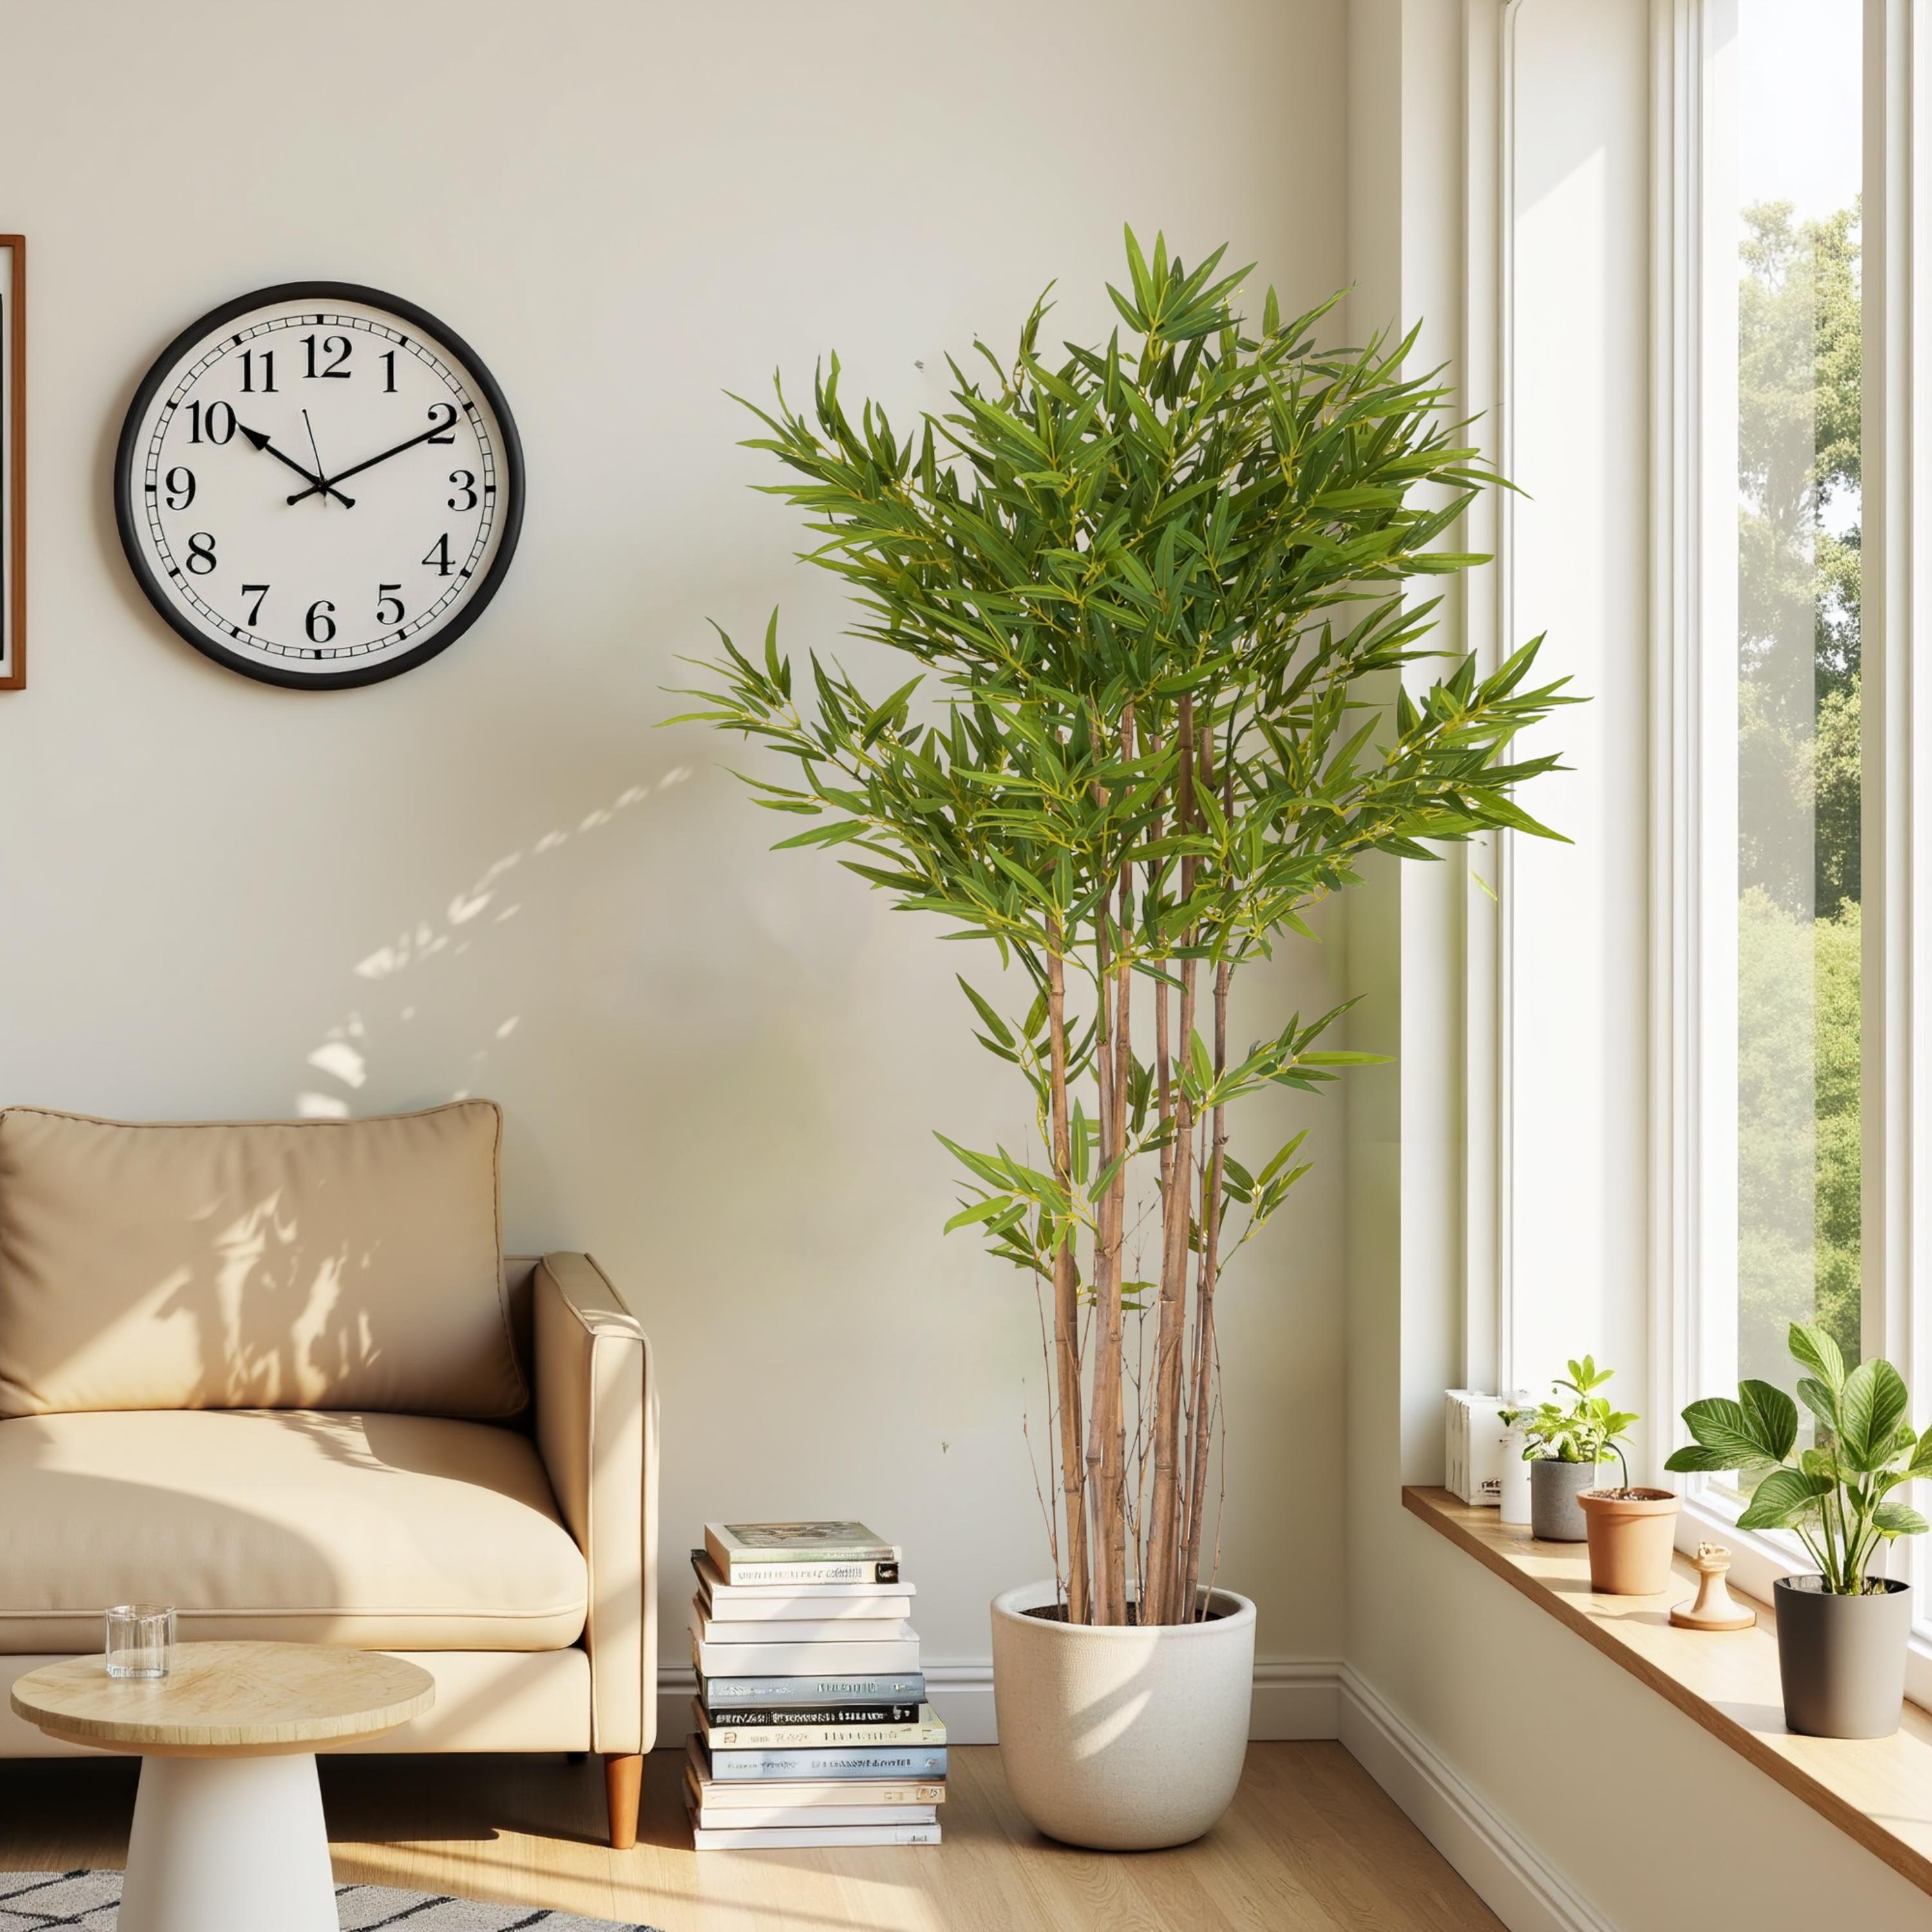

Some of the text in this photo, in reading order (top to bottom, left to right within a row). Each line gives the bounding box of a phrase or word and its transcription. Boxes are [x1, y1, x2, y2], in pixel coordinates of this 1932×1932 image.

[236, 348, 279, 393] 11
[299, 334, 352, 379] 12
[379, 350, 398, 393] 1
[185, 399, 236, 446] 10
[427, 402, 459, 444] 2
[166, 466, 196, 511] 9
[448, 469, 478, 512] 3
[185, 532, 217, 575] 8
[421, 533, 456, 576] 4
[241, 583, 270, 627] 7
[305, 600, 336, 643] 6
[376, 583, 405, 625] 5
